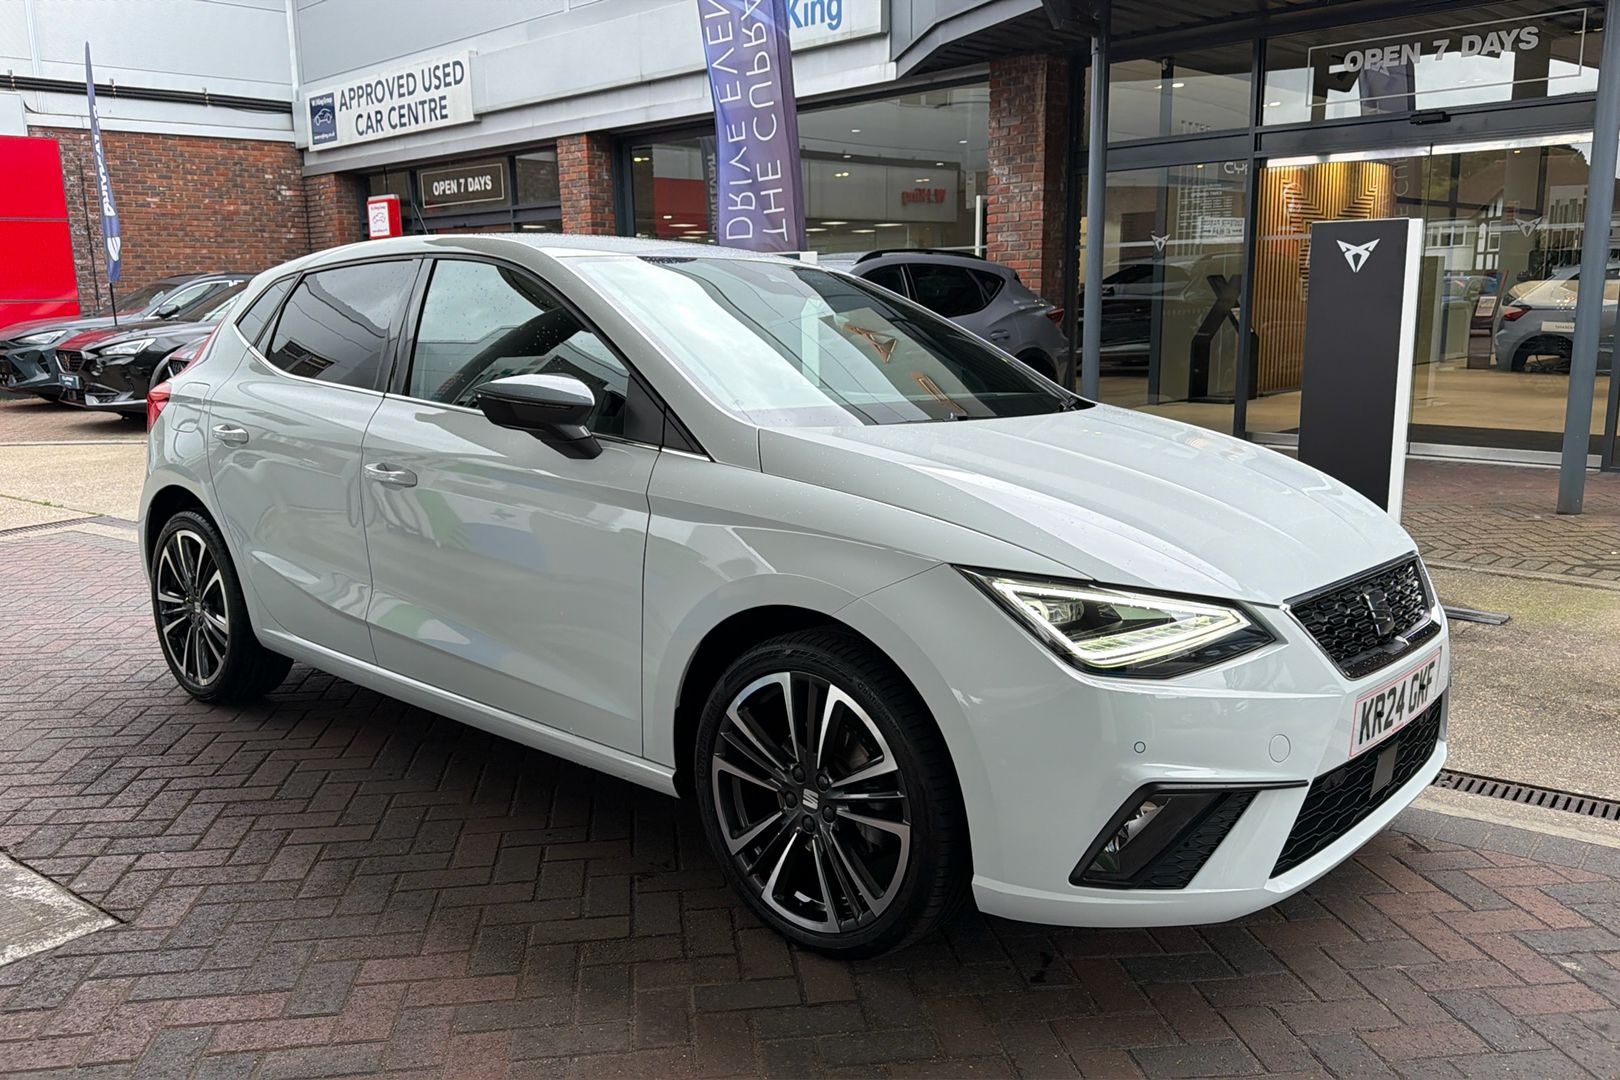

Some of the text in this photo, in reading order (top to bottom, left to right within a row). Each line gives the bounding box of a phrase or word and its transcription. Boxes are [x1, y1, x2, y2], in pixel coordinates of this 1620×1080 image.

[1344, 26, 1539, 73] OPEN 7 DAYS
[339, 60, 465, 112] APPROVED USED
[355, 95, 449, 136] CAR CENTRE
[433, 175, 492, 196] OPEN 7 DAYS
[1359, 680, 1406, 745] KR24
